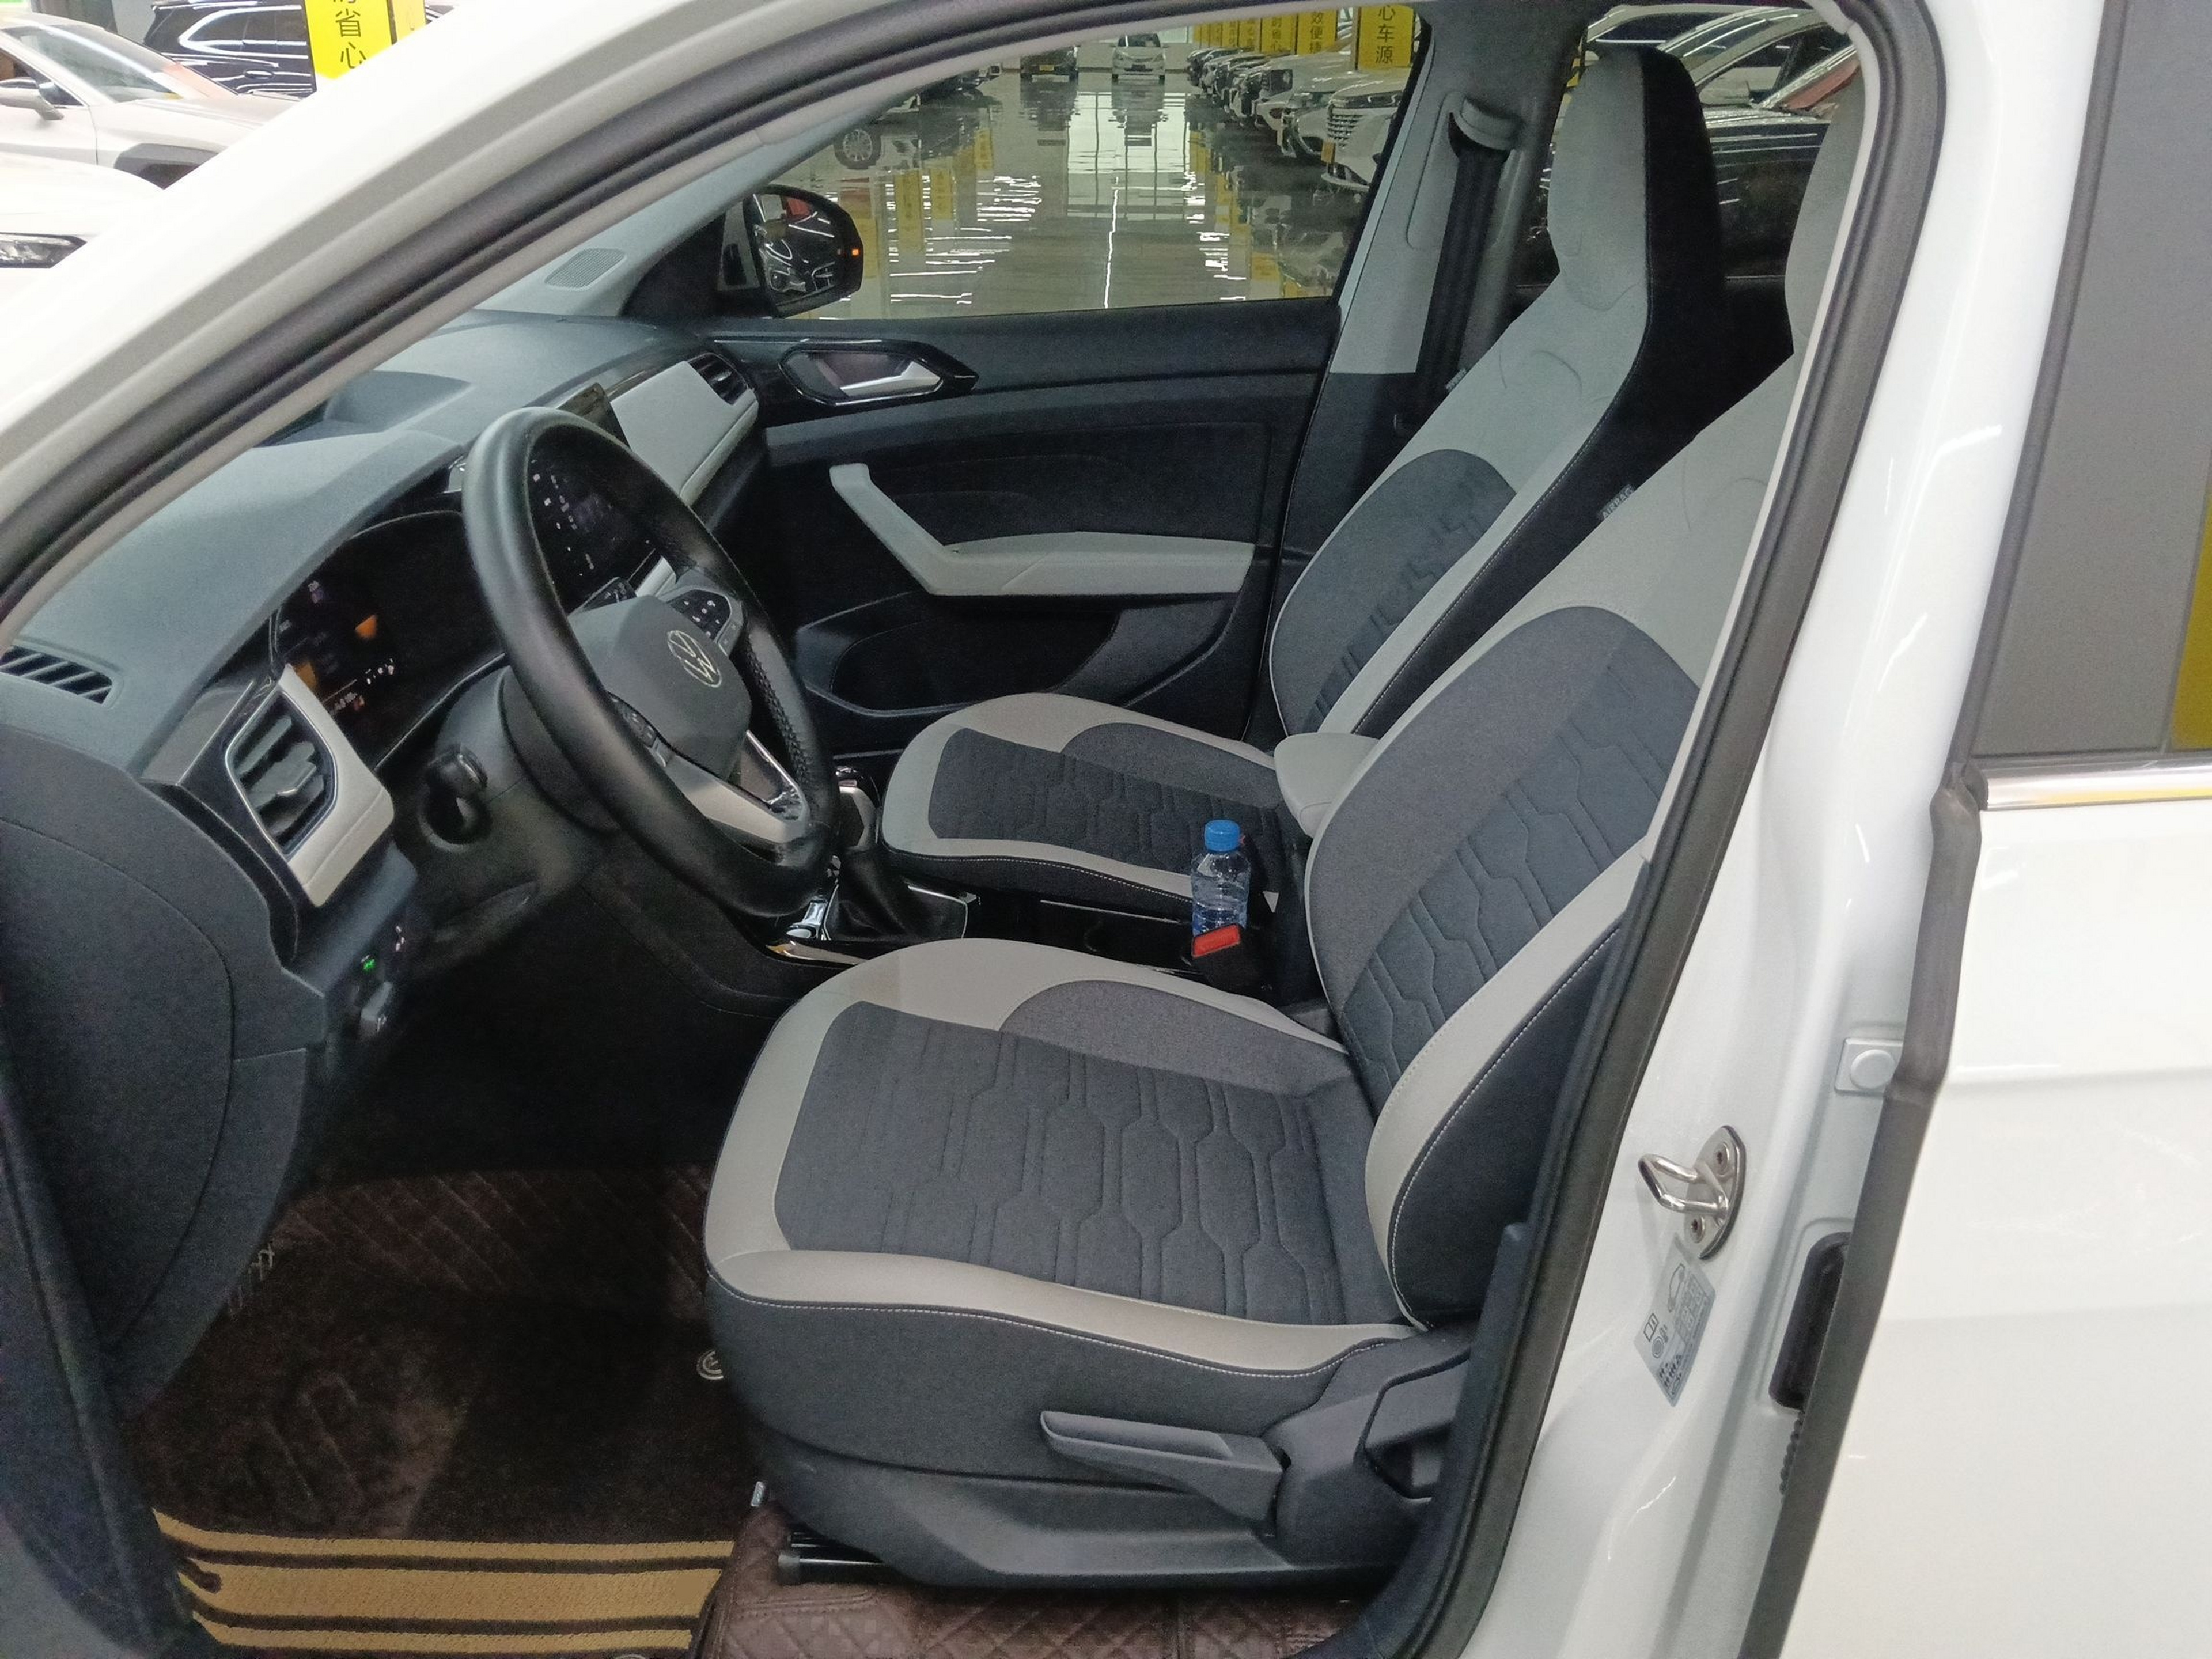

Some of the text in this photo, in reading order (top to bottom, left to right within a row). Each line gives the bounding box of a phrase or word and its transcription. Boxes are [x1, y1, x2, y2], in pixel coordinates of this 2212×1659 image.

[333, 0, 366, 69] 省心
[1376, 5, 1396, 64] 心车源
